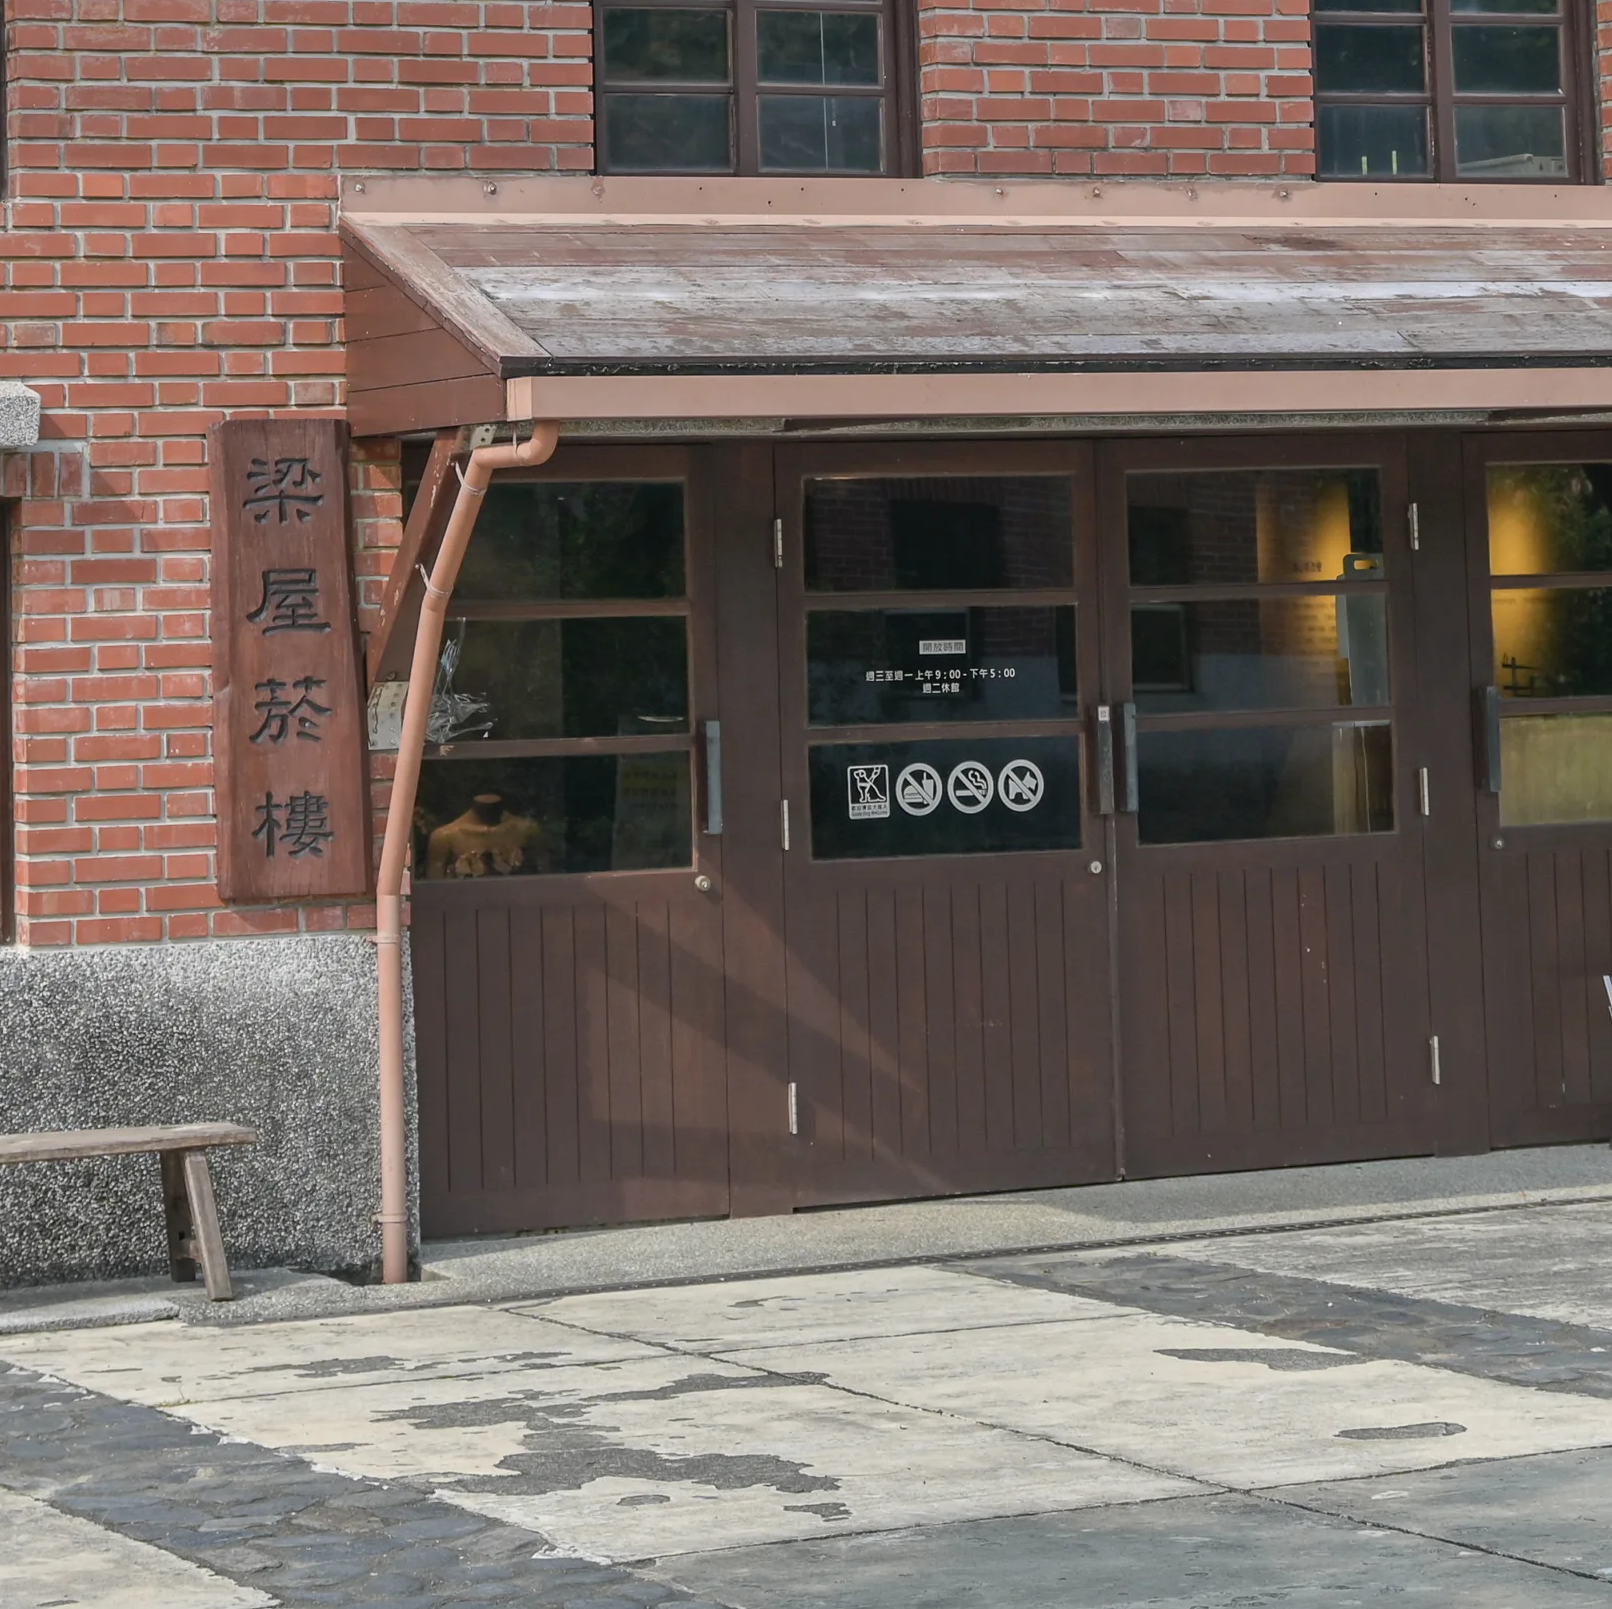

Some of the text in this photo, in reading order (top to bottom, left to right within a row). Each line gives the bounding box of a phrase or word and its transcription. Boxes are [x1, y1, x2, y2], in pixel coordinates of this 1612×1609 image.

[922, 642, 964, 652] 開放時間
[242, 457, 334, 859] 梁屋菸樓
[922, 682, 960, 694] 週二休館
